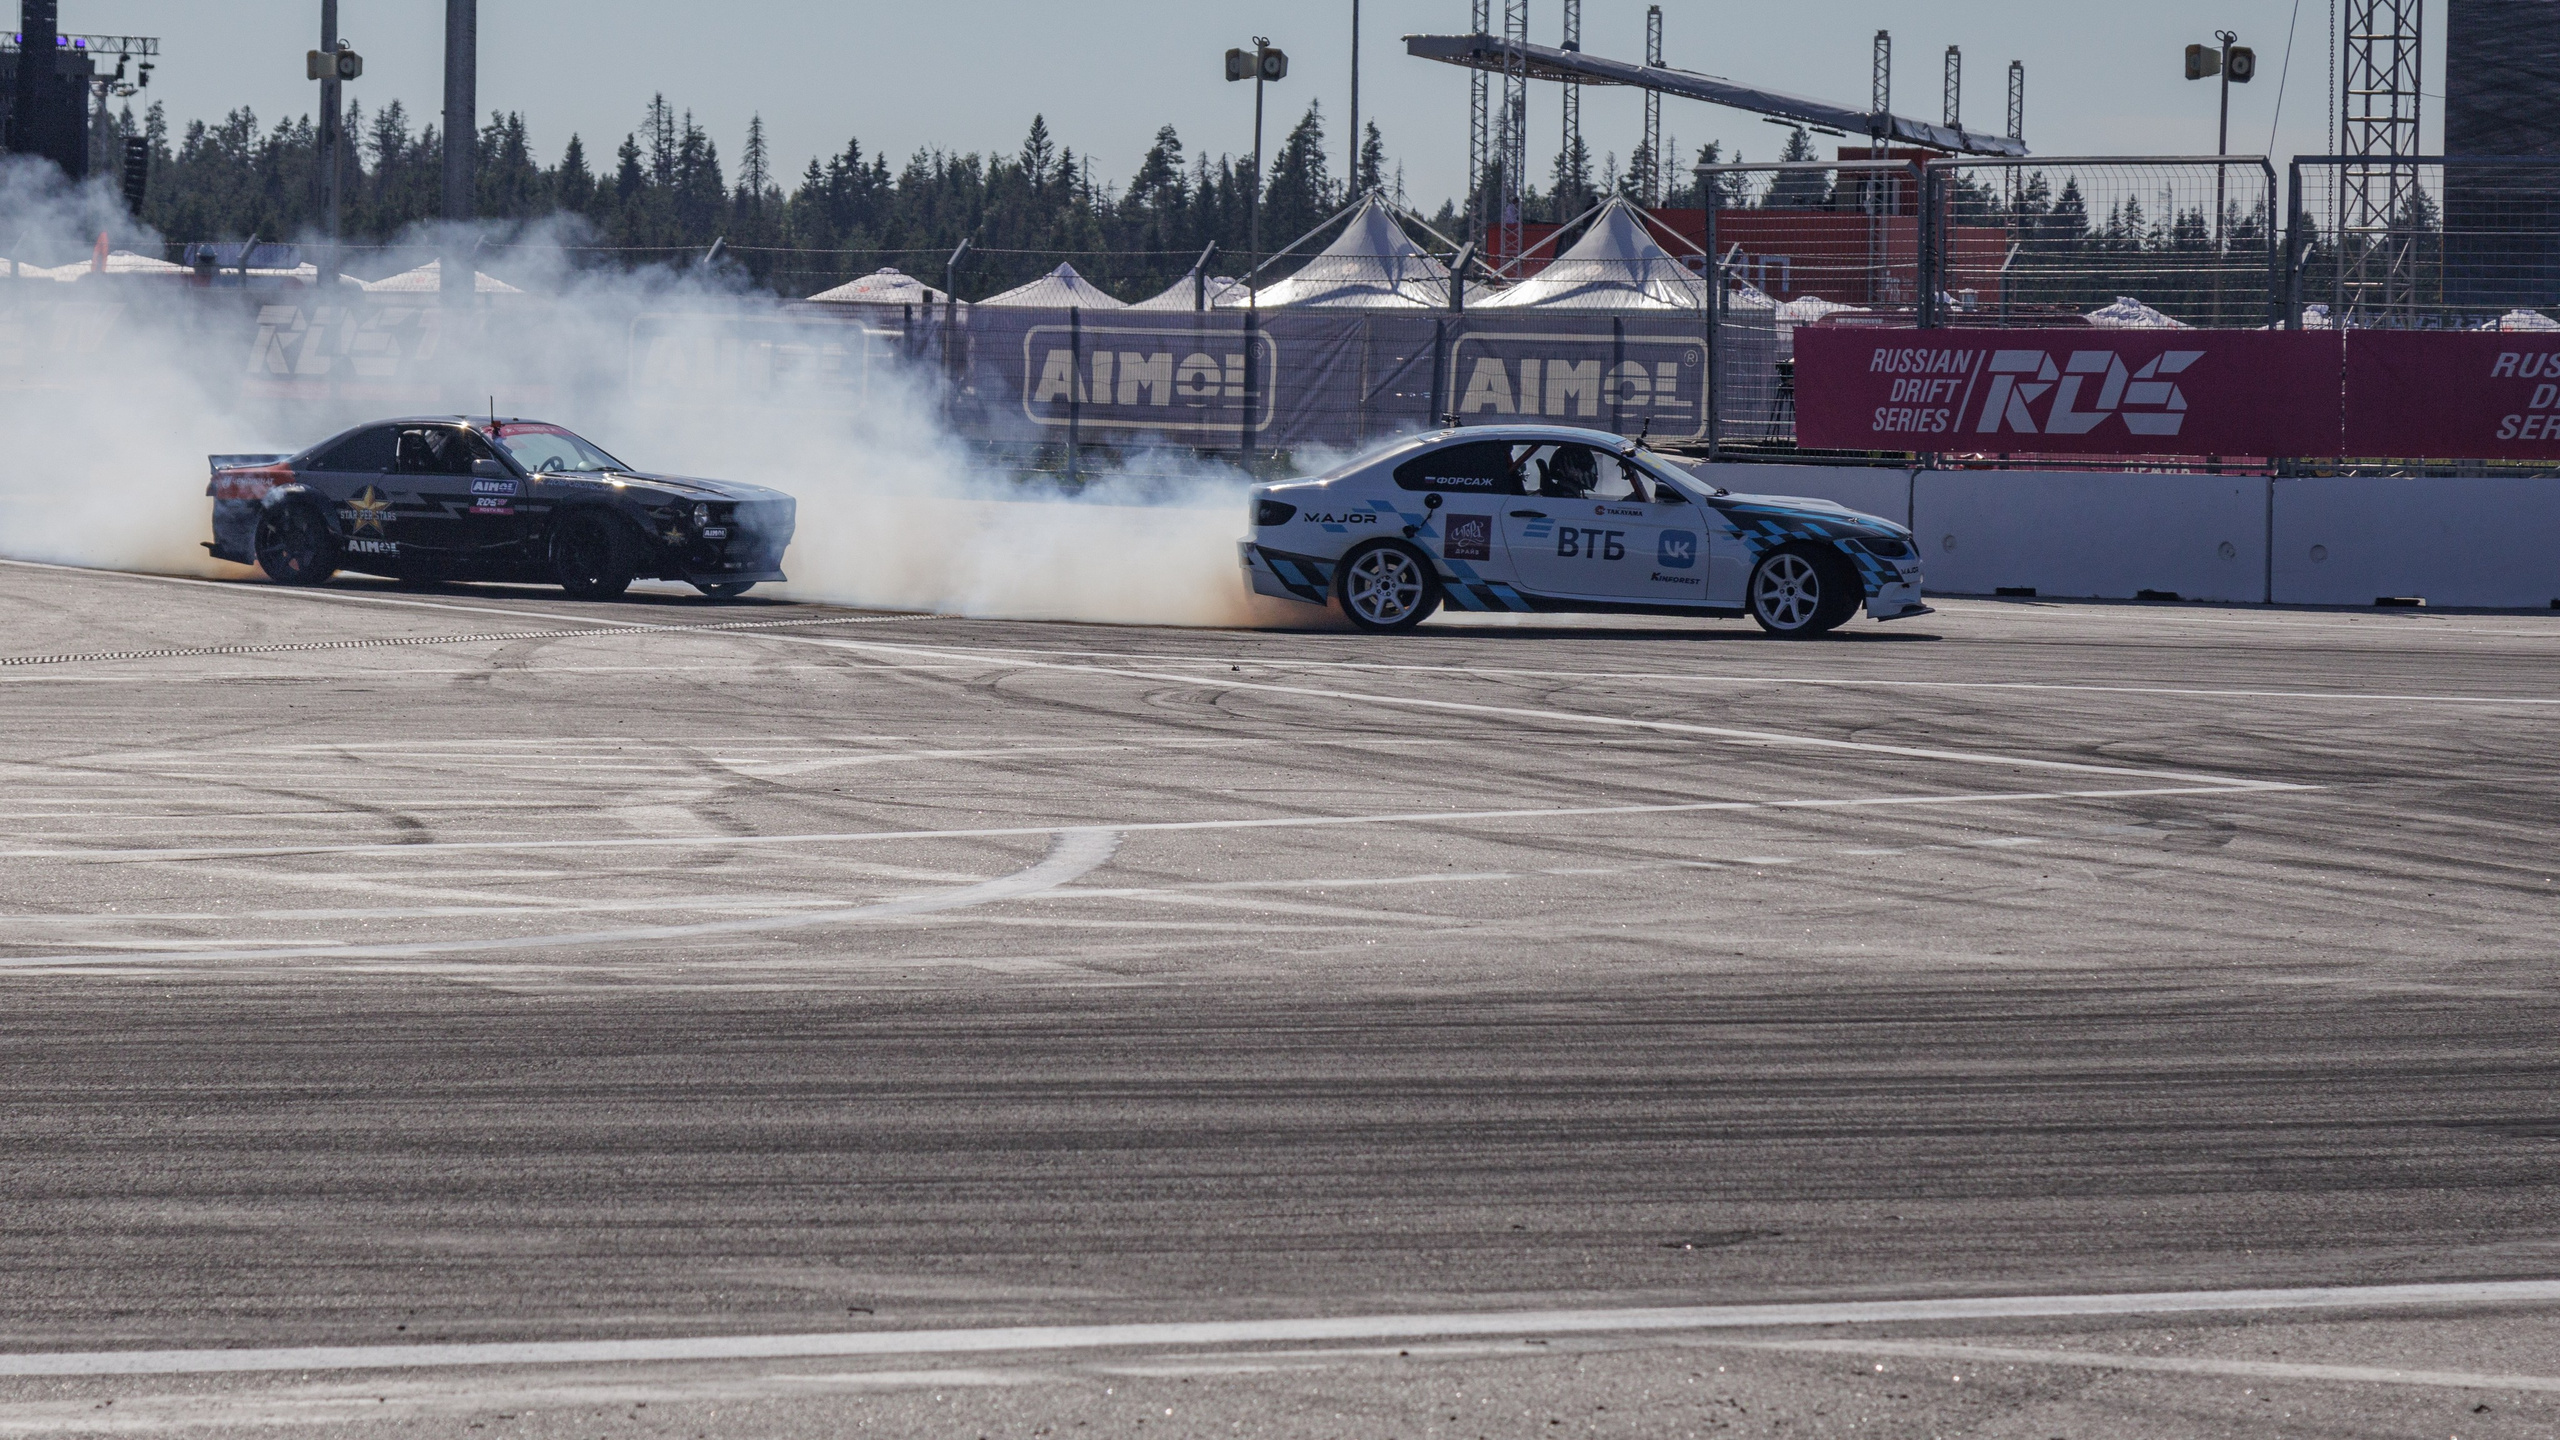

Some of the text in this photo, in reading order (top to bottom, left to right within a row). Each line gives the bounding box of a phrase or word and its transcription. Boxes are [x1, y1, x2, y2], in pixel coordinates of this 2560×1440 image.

[1869, 348, 1973, 374] RUSSIAN
[1033, 349, 1261, 408] AIMOL
[1459, 357, 1693, 418] AIMOL
[1889, 379, 1962, 403] DRIFT
[1976, 349, 2208, 436] RDS
[2528, 383, 2560, 409] D
[1872, 407, 1950, 433] SERIES
[472, 480, 514, 493] AIMOL
[1436, 476, 1494, 487] ФОРСАЖ
[476, 497, 497, 507] RDS
[340, 509, 357, 519] STAR
[375, 510, 397, 521] STARS
[1304, 512, 1377, 524] MAJOR
[1606, 508, 1643, 517] TAKAYAMA
[704, 529, 726, 537] AIMOL
[347, 540, 400, 555] AIMOL
[1557, 526, 1625, 561] ВТБ
[1664, 540, 1690, 559] VK
[1455, 548, 1480, 556] ДРАЙВ
[1651, 572, 1701, 585] KINFOREST
